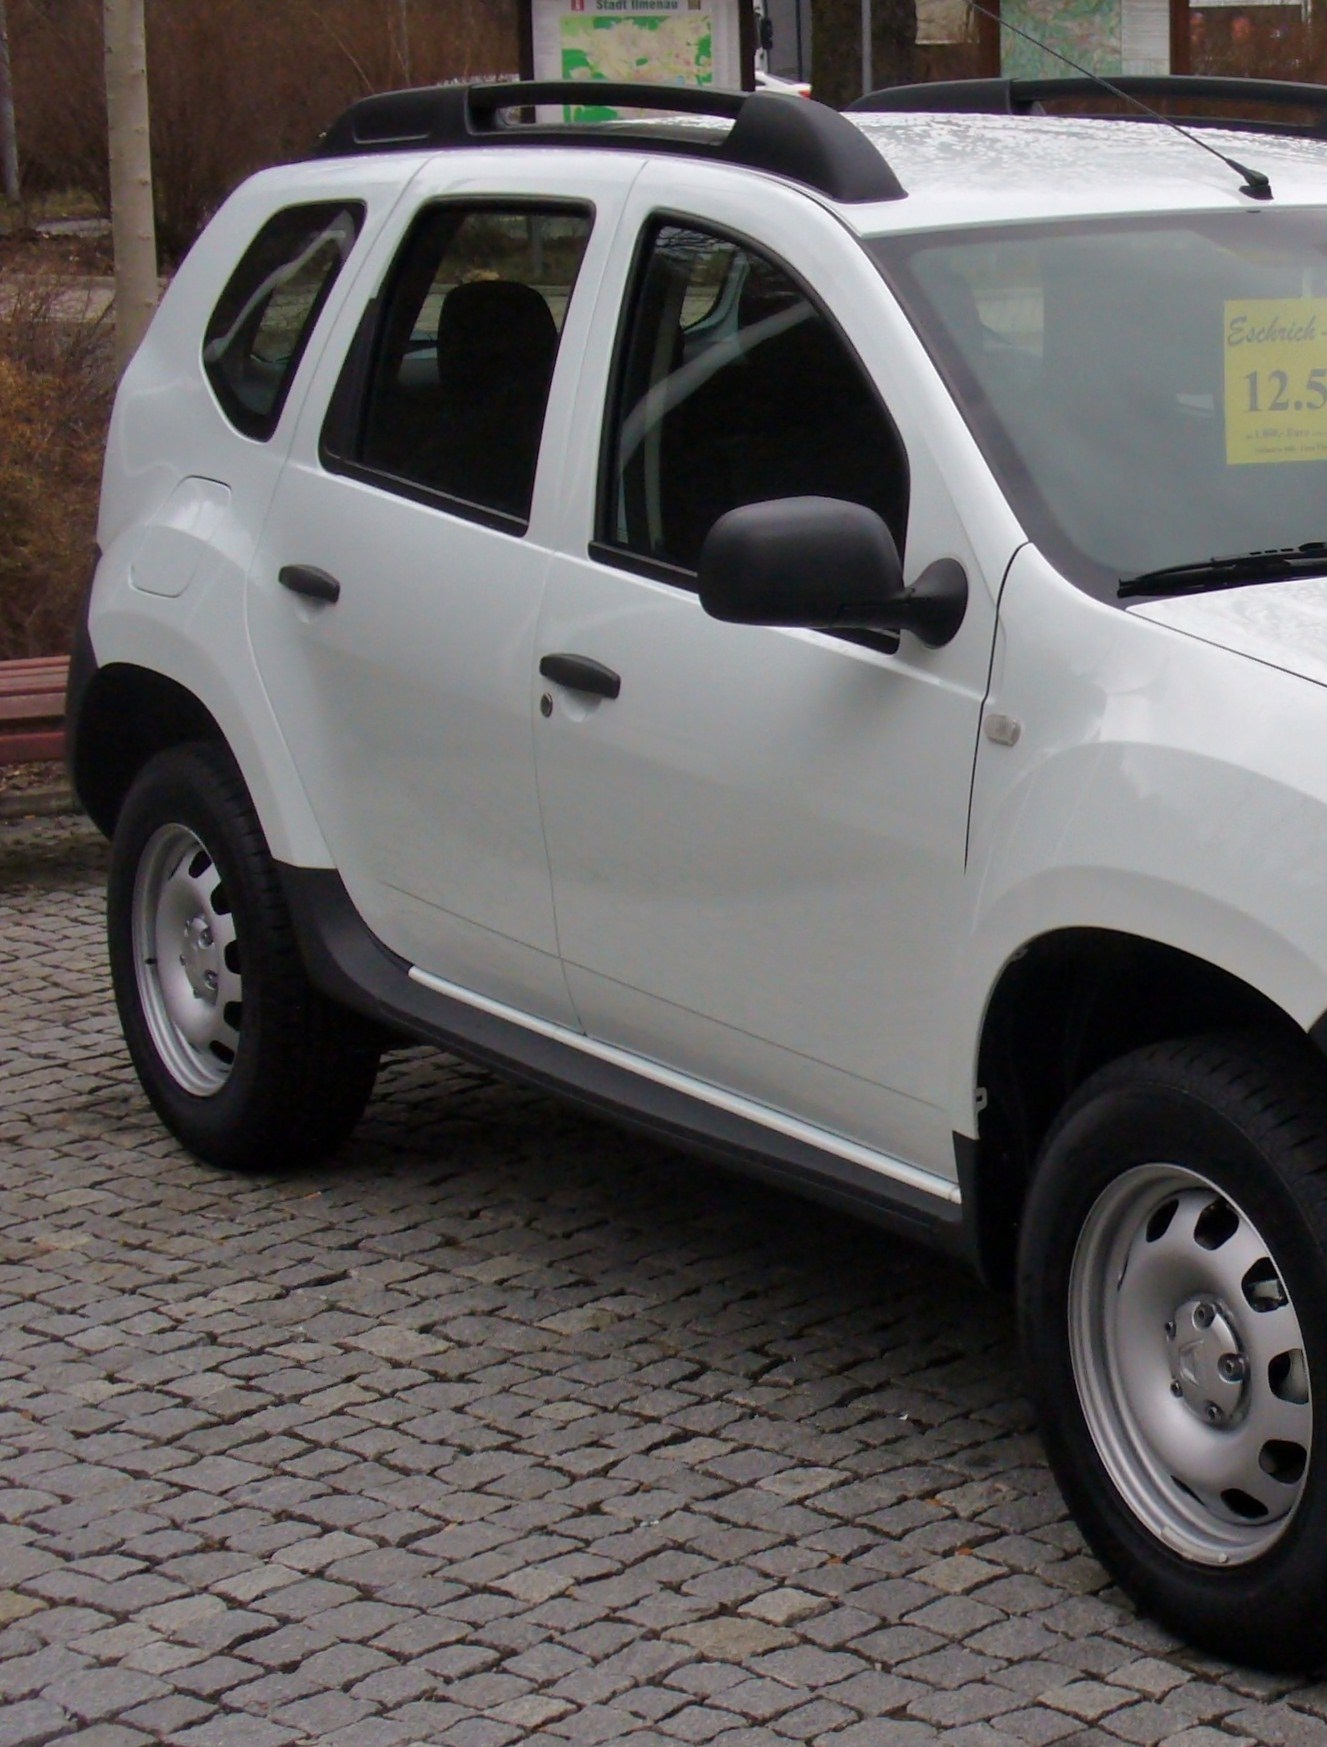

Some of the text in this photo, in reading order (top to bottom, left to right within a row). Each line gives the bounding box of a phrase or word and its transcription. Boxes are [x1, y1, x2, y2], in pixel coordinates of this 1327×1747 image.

[596, 0, 678, 10] Stadt Ilmenau
[1228, 315, 1317, 346] Eschrich
